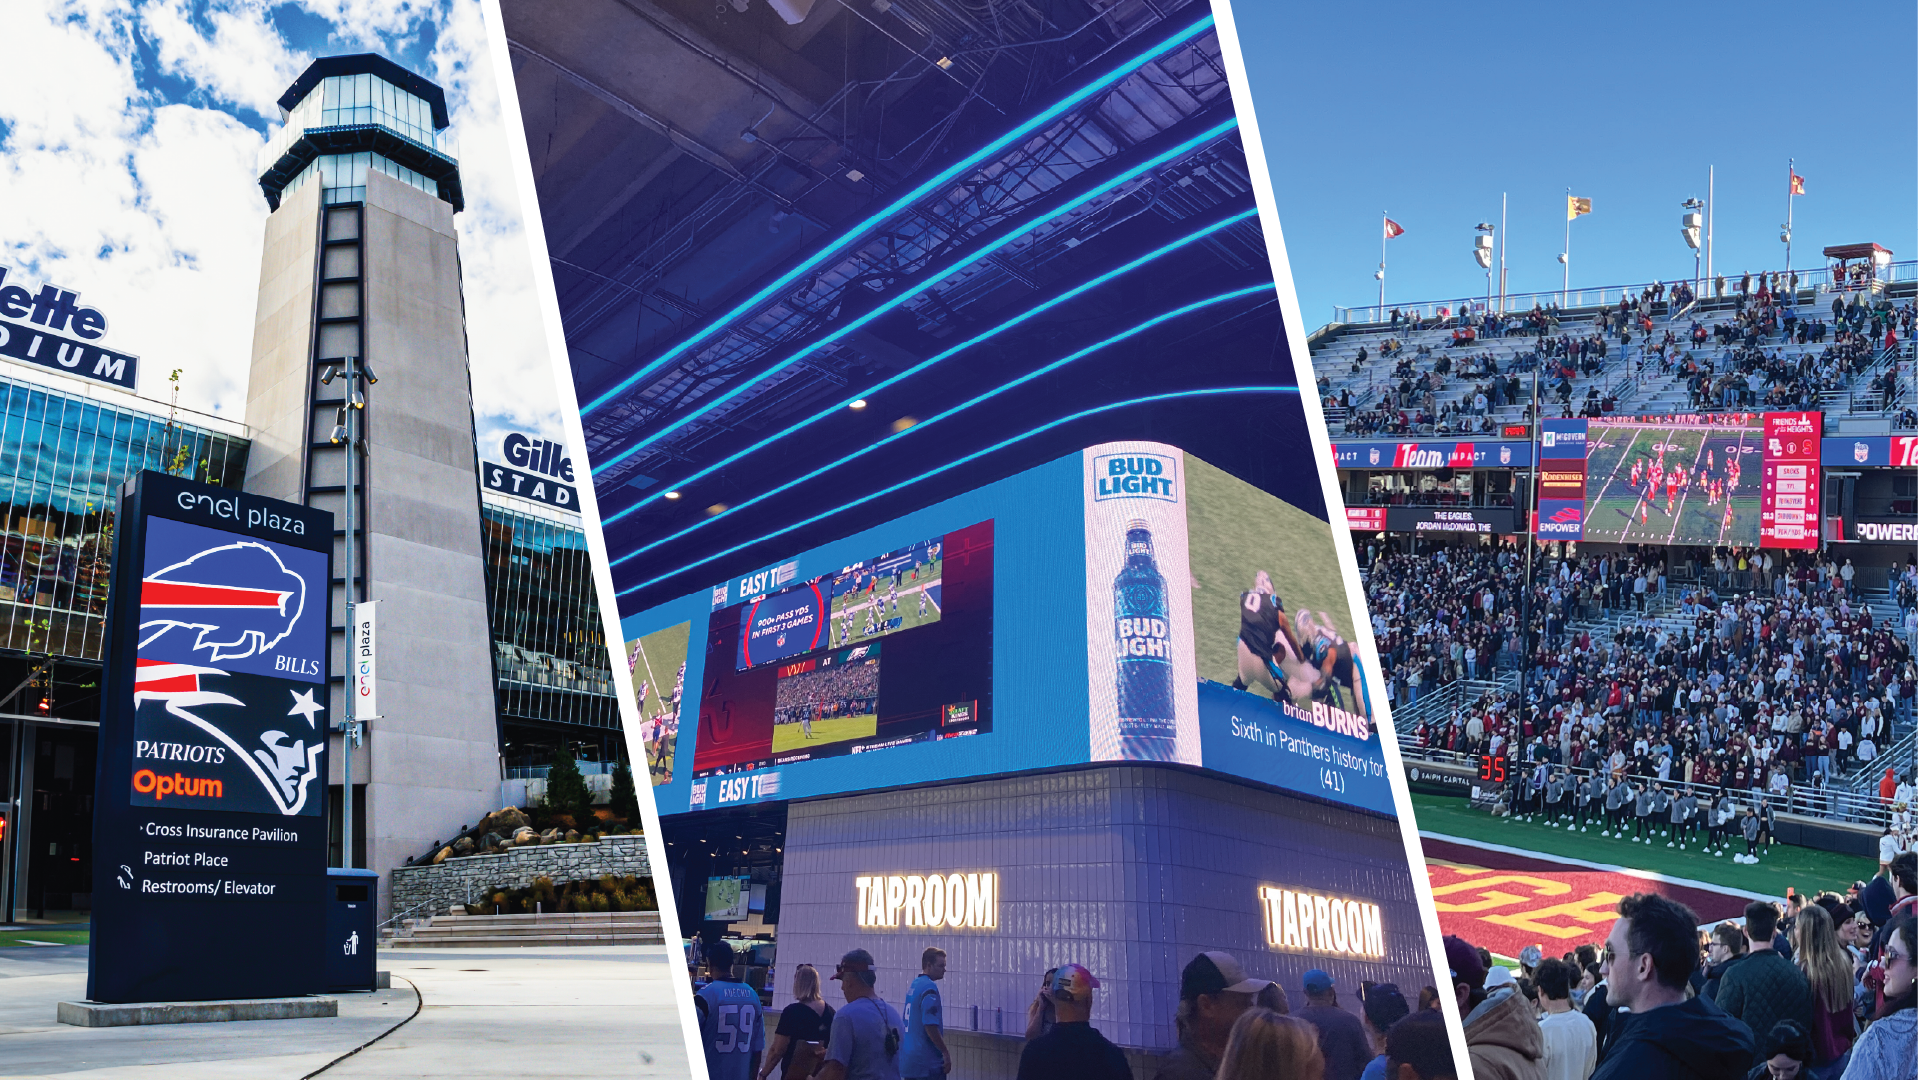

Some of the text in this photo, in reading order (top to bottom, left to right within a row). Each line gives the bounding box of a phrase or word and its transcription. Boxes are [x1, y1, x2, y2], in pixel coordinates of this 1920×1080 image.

[0, 266, 105, 340] ette
[1772, 418, 1797, 426] FRIENDS
[504, 433, 575, 482] Gille
[1108, 457, 1163, 476] BUD
[1402, 444, 1444, 467] Team
[1448, 452, 1486, 461] IMPACT
[490, 469, 570, 504] STAD
[1099, 476, 1173, 496] LIGHT
[177, 491, 305, 535] enel plaza
[1434, 511, 1447, 520] THE
[1416, 522, 1441, 530] JORDAN
[1478, 523, 1491, 532] THE
[1540, 523, 1580, 533] EMPOWER
[740, 570, 769, 597] EASY
[776, 610, 794, 622] PASS
[795, 605, 809, 616] YDS
[752, 614, 814, 639] IN FIRST 3 GAMES
[1119, 618, 1167, 638] BUD
[274, 654, 320, 676] BILLS
[357, 621, 373, 696] enel plaza
[822, 657, 831, 667] AT
[1283, 700, 1369, 741] brian BURNS
[136, 740, 226, 764] PATRIOTS
[1231, 715, 1384, 778] Sixth in Panthers history for
[1320, 766, 1345, 794] (41)
[1481, 755, 1505, 783] 35
[133, 769, 223, 800] Optum
[719, 776, 750, 803] EASY
[146, 822, 298, 842] Cross Insurance Pavilion
[144, 851, 229, 867] Patriot Place
[142, 879, 276, 896] Restrooms/ Elevator
[855, 872, 999, 928] TAPROOM
[1259, 886, 1385, 957] TAPROOM
[715, 1004, 756, 1053] 59
